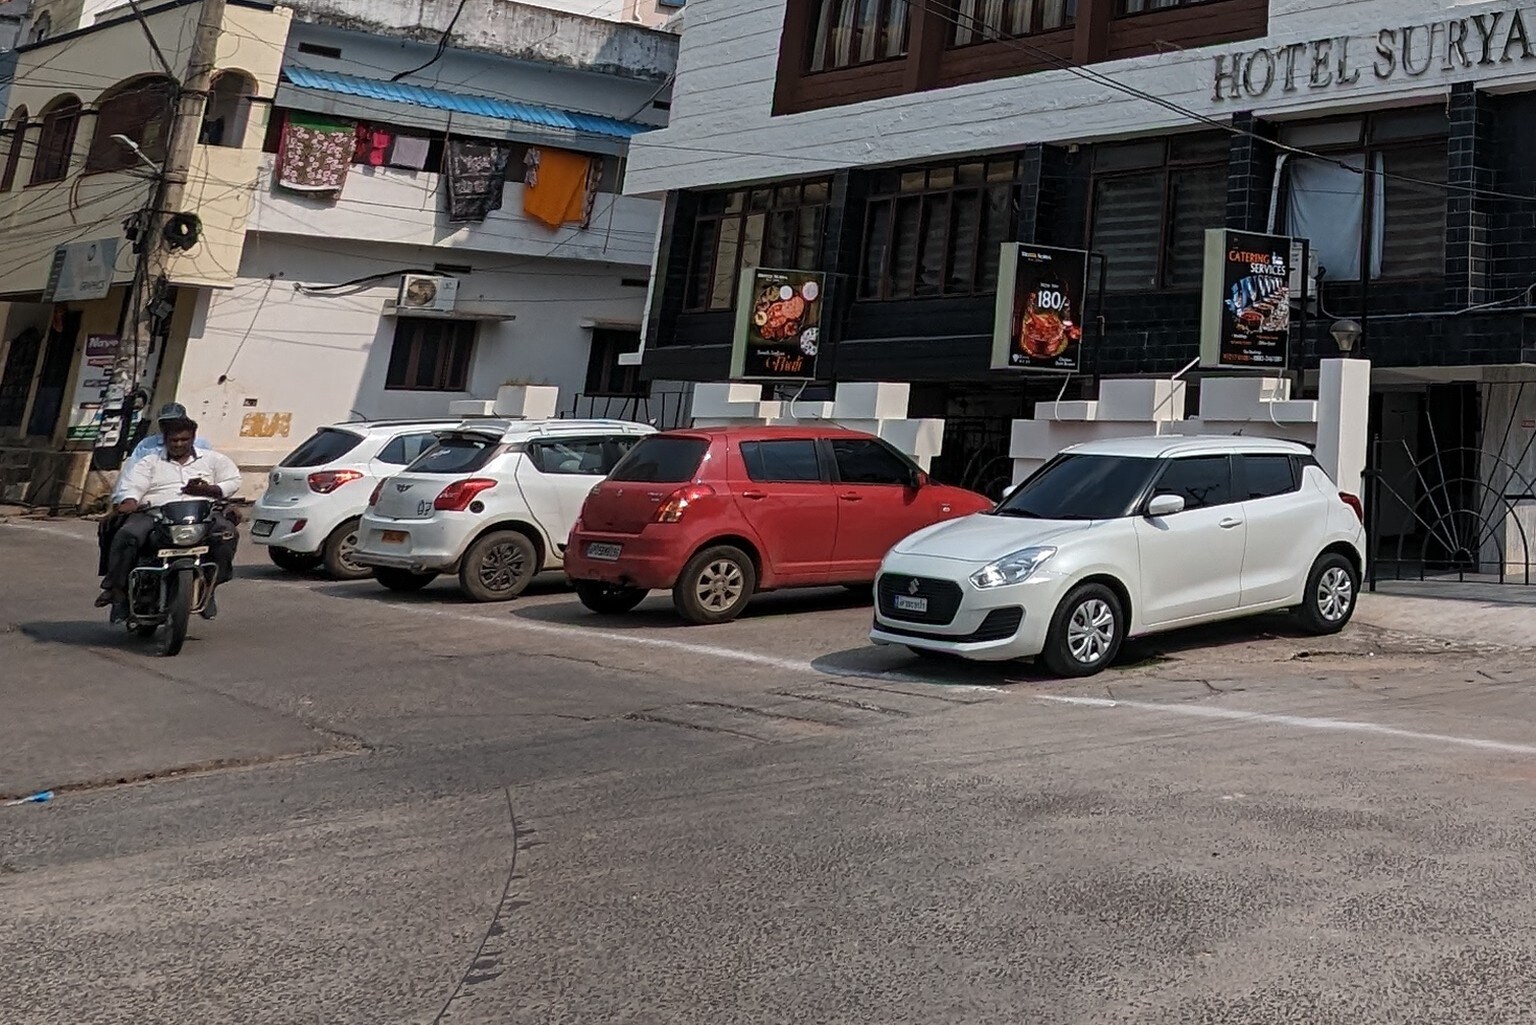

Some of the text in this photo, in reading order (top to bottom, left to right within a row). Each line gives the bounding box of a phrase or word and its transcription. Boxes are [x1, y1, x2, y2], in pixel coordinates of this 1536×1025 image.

[1211, 7, 1536, 102] HOTEL SURYA
[1228, 251, 1270, 264] CATERING
[1249, 262, 1286, 276] SERVICES
